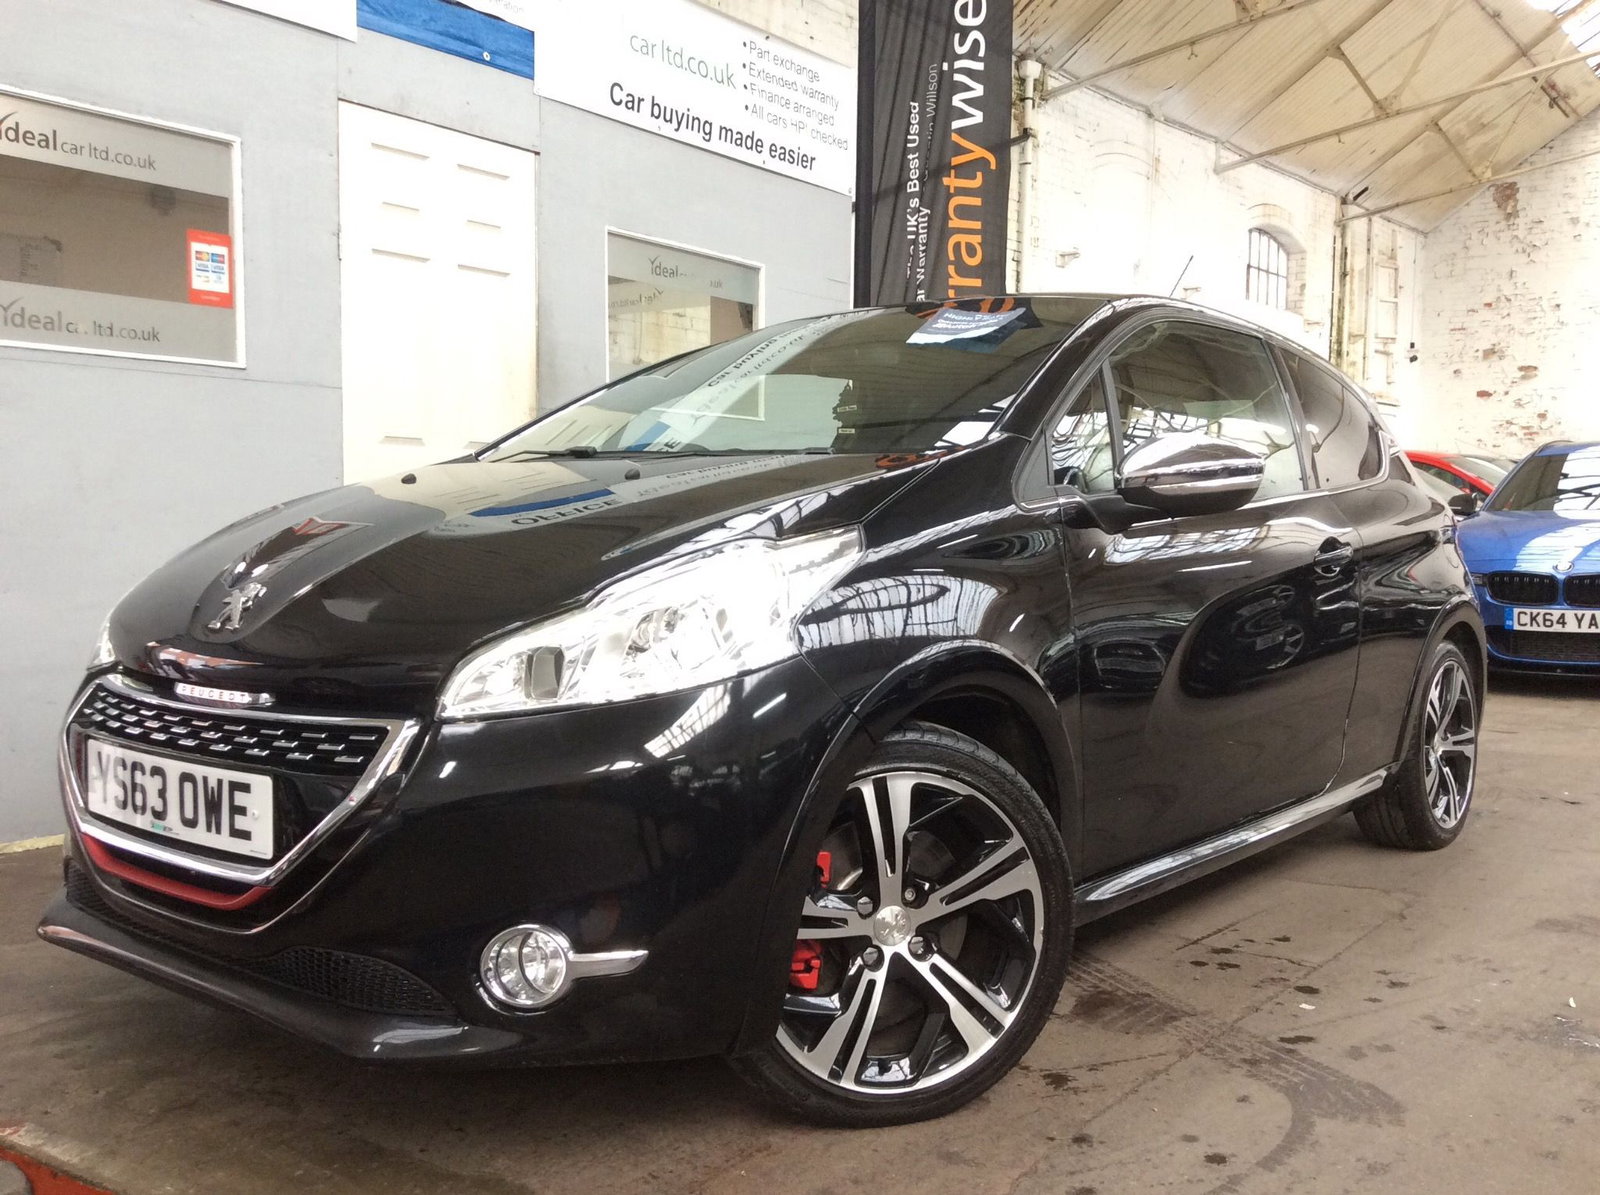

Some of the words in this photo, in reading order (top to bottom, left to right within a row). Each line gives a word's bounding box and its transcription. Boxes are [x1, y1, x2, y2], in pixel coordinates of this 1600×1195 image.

[629, 35, 657, 58] car
[661, 40, 736, 89] ltd.co.uk
[749, 40, 770, 62] Part
[773, 54, 820, 83] exchange
[749, 61, 798, 92] Extended
[801, 85, 839, 111] warranty
[750, 82, 791, 109] Finance
[793, 102, 834, 126] arranged
[610, 82, 645, 113] Car
[650, 96, 713, 142] buying
[719, 125, 764, 154] made
[769, 142, 816, 171] easier
[751, 104, 764, 120] All
[767, 112, 788, 129] cars
[811, 128, 848, 151] checked
[906, 101, 920, 148] Used
[60, 142, 85, 156] car
[88, 143, 157, 171] ltd.co.uk
[942, 0, 997, 298] rantywise
[907, 152, 920, 193] Best
[917, 207, 931, 285] Warranty
[926, 64, 938, 117] Willson
[648, 255, 679, 278] Ydeal
[93, 320, 161, 342] ltd.co.uk
[1517, 611, 1567, 629] CK64
[181, 684, 247, 700] PEUGEOT
[97, 751, 168, 822] YS63
[178, 771, 252, 842] OWE
